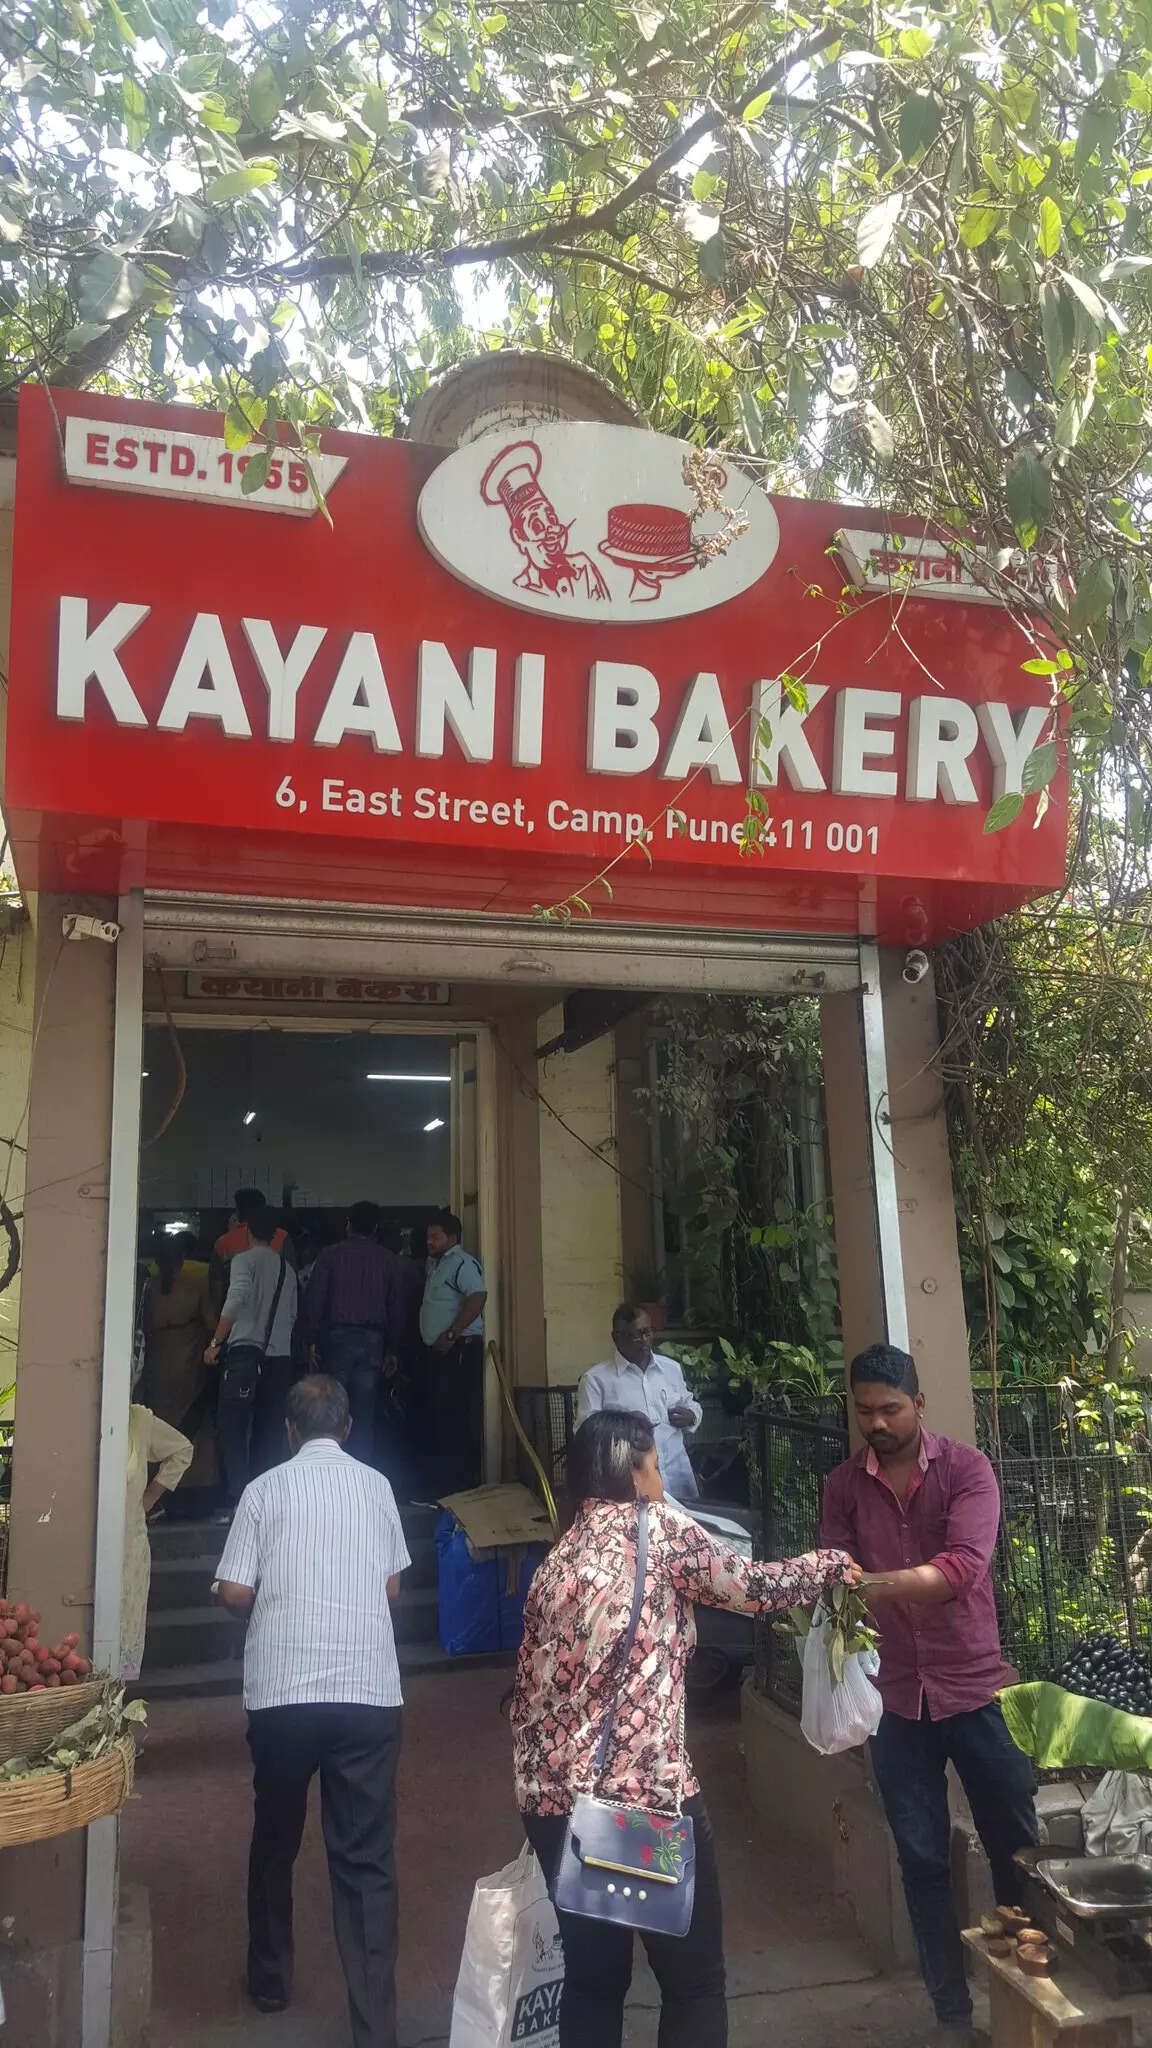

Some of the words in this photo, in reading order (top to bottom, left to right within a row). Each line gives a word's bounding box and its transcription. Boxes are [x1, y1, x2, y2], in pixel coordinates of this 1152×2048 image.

[86, 433, 207, 480] ESTD.
[57, 596, 546, 768] KAYANI
[587, 661, 1051, 805] BAKERY
[275, 776, 307, 813] 6,
[322, 779, 402, 816] East
[413, 788, 535, 834] Street,
[547, 800, 654, 843] Camp,
[666, 806, 746, 844] Pune
[826, 823, 880, 855] 001
